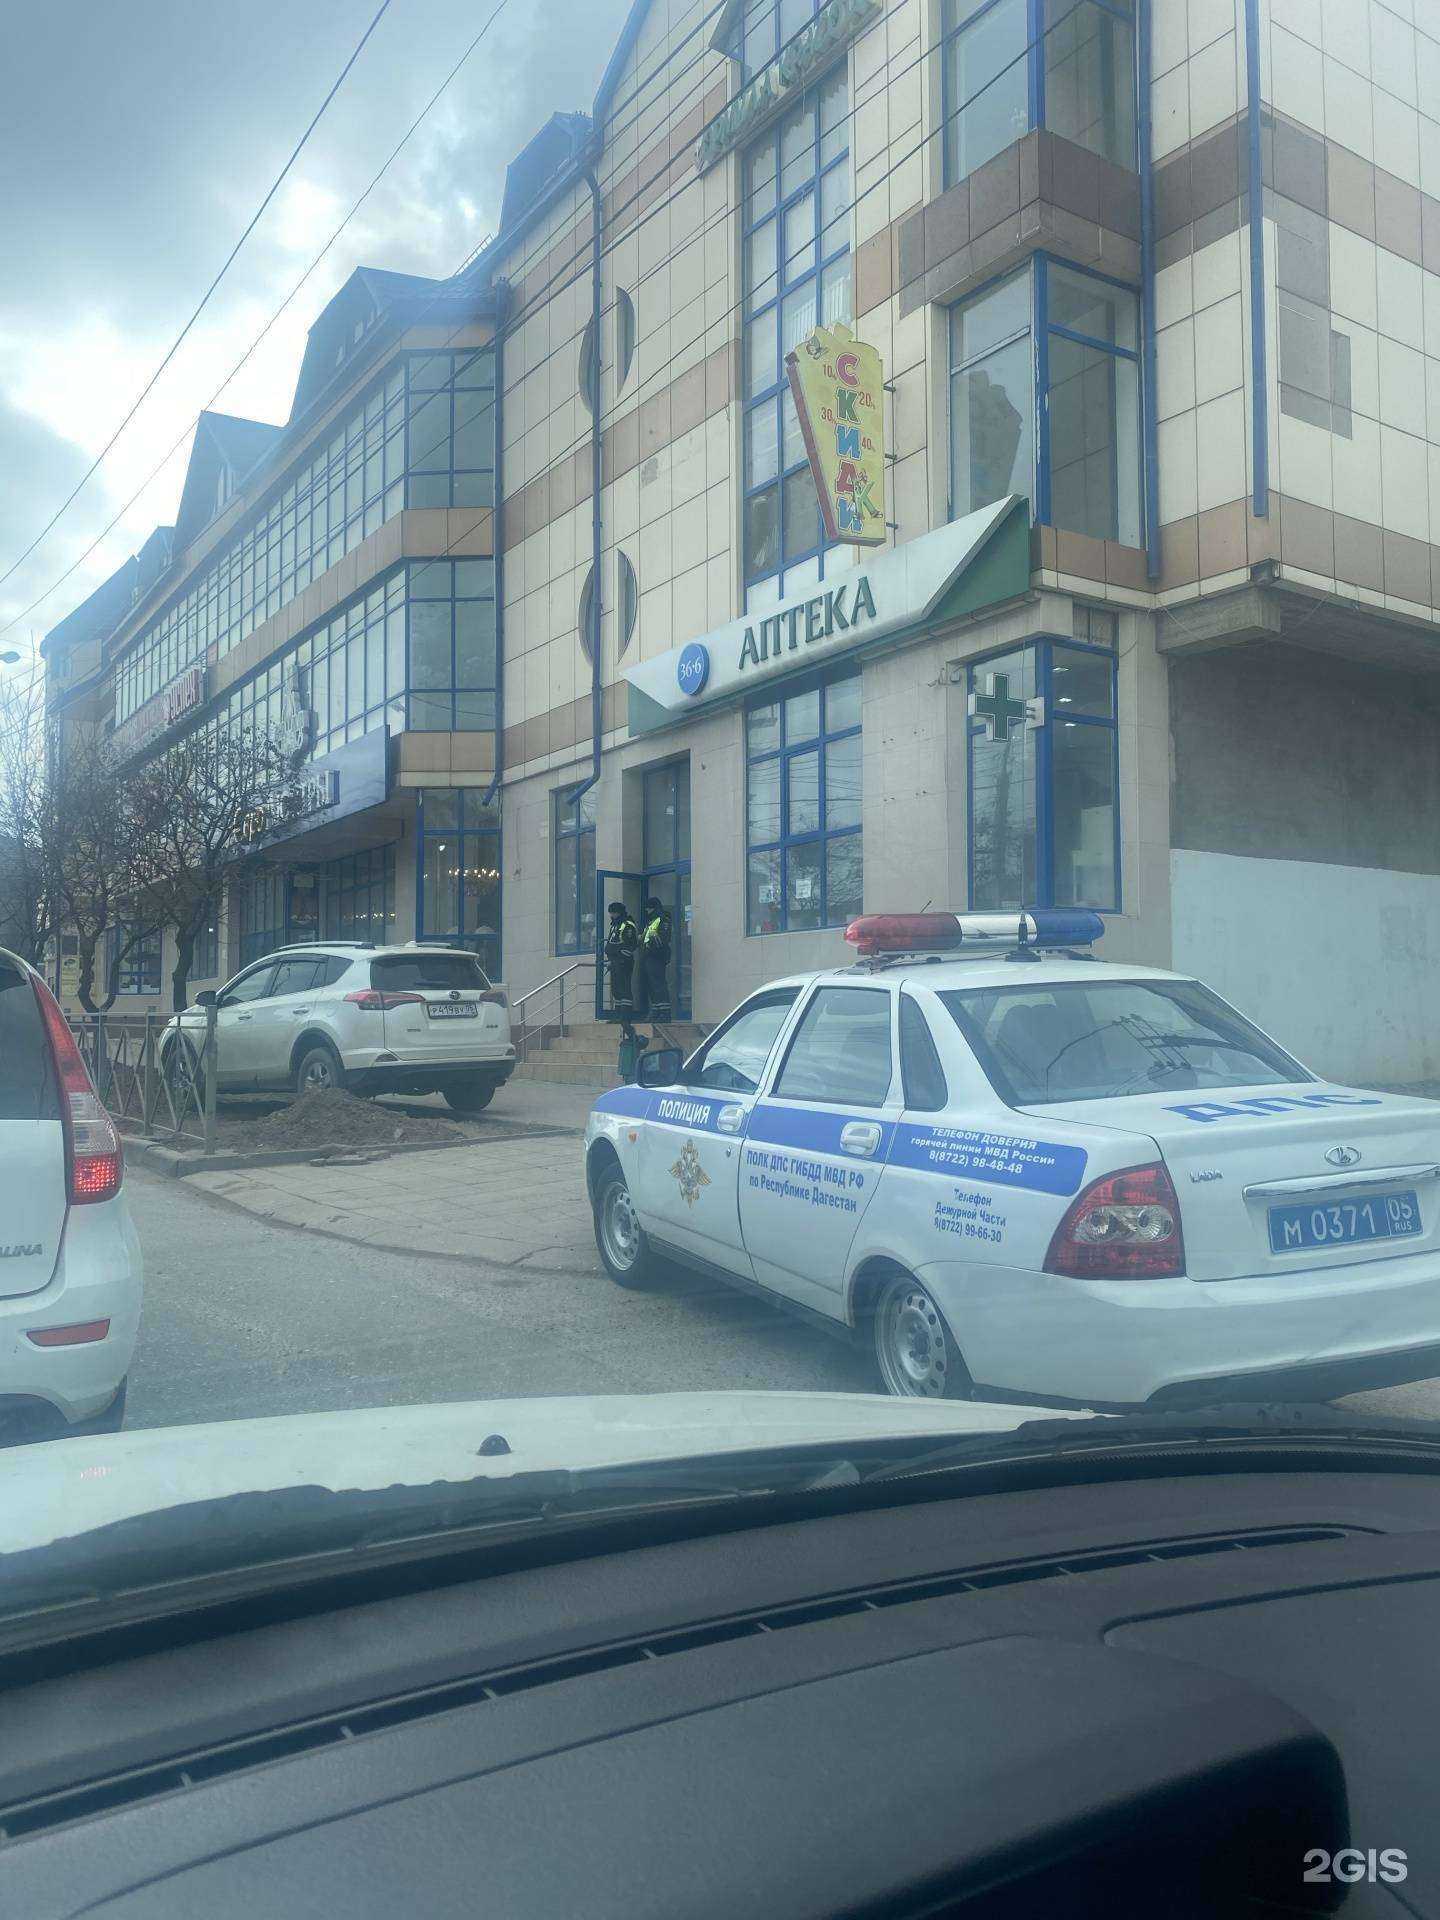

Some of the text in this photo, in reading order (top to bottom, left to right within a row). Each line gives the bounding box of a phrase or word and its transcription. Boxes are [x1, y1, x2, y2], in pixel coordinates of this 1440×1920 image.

[738, 576, 877, 670] АПТЕКА
[657, 1098, 711, 1125] ПОЛИЦИЯ
[1161, 1094, 1383, 1123] ДПС
[911, 1137, 1056, 1166] горячей линии МВД России
[932, 1127, 1038, 1151] ТЕЛЕФОН ДОВЕРИЯ
[746, 1150, 865, 1189] ПОЛК ДПС ГИБДД МВД РФ
[929, 1150, 1023, 1174] 8(8722) 98-48-48
[749, 1175, 857, 1212] по Республике Дагестан
[953, 1188, 993, 1207] Телефон
[935, 1201, 1007, 1227] Дежурной Части
[1283, 1197, 1413, 1245] М 0371 05
[1395, 1222, 1412, 1232] RUS
[934, 1217, 1002, 1242] 8(8722) 99-66-30
